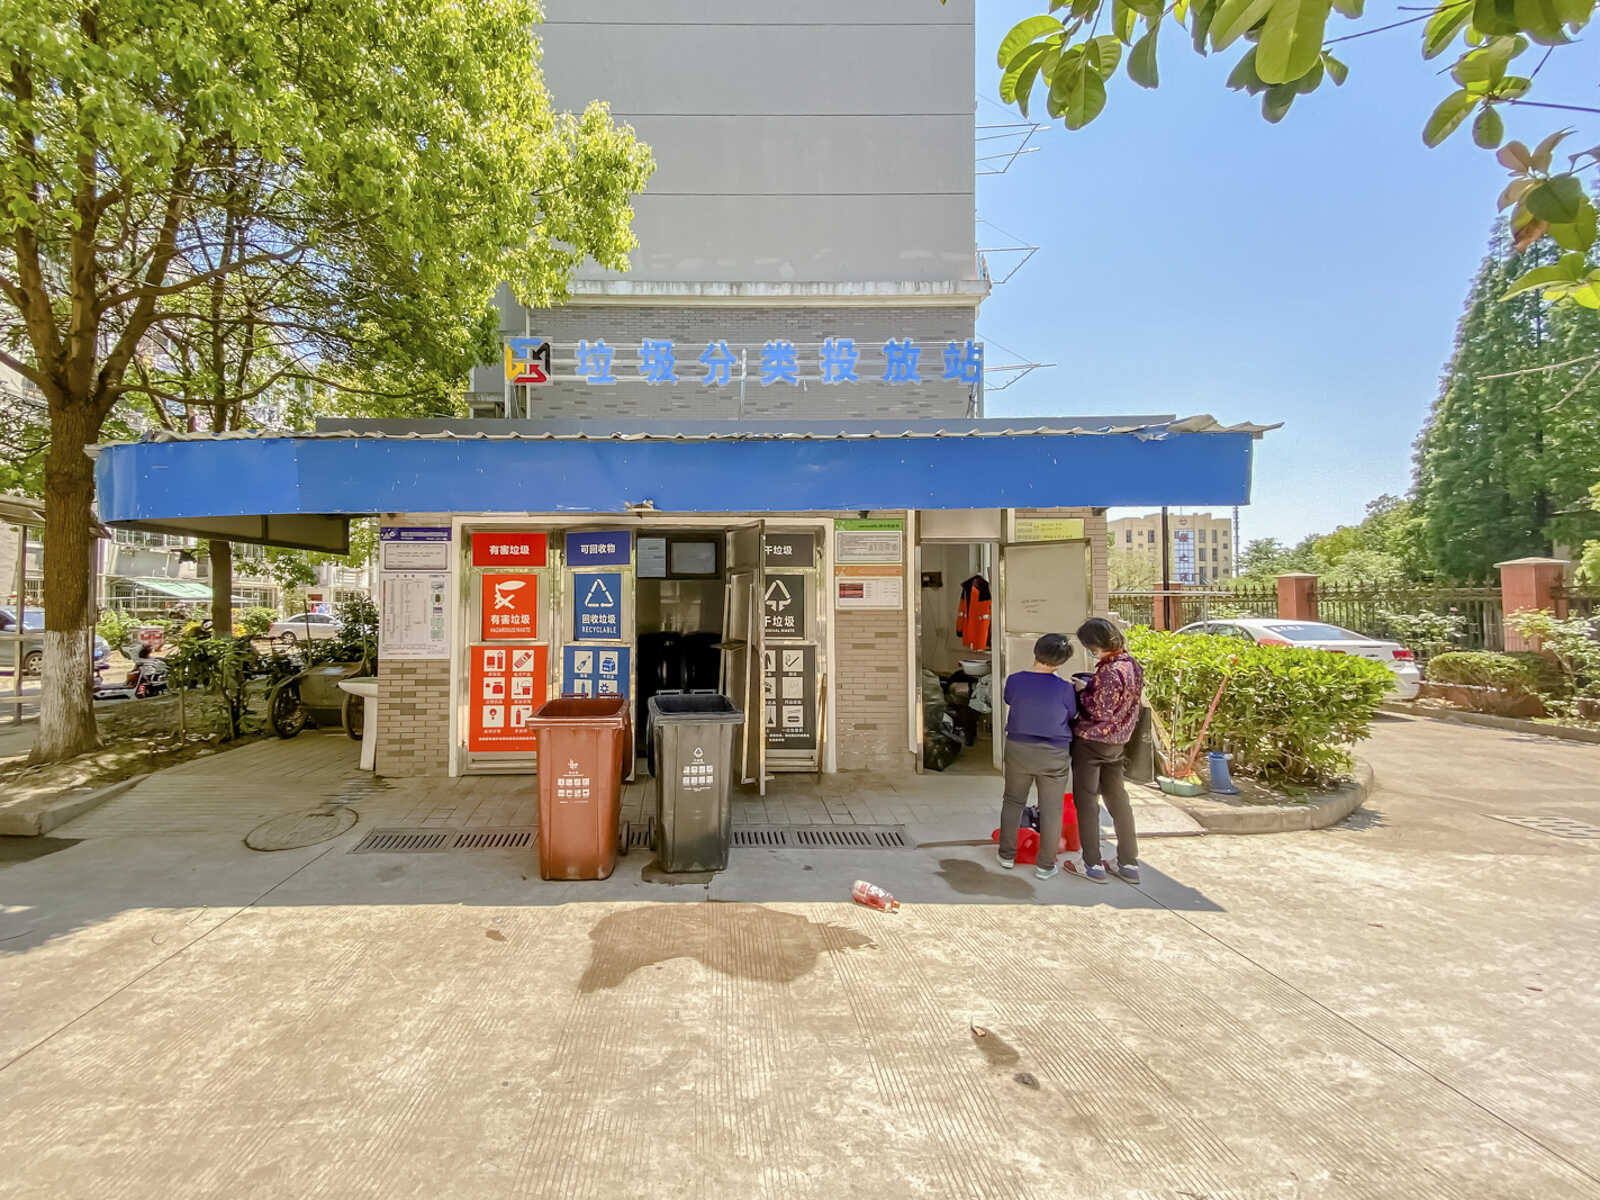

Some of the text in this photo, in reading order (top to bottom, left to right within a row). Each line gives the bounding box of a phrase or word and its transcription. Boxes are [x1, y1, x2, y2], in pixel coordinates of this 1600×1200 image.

[576, 337, 981, 385] 垃圾分类投放站
[489, 545, 530, 555] 有害垃圾
[580, 543, 616, 554] 可回收物
[764, 545, 793, 555] 干垃圾
[491, 614, 531, 625] 有害垃圾
[581, 613, 616, 624] 回收垃圾
